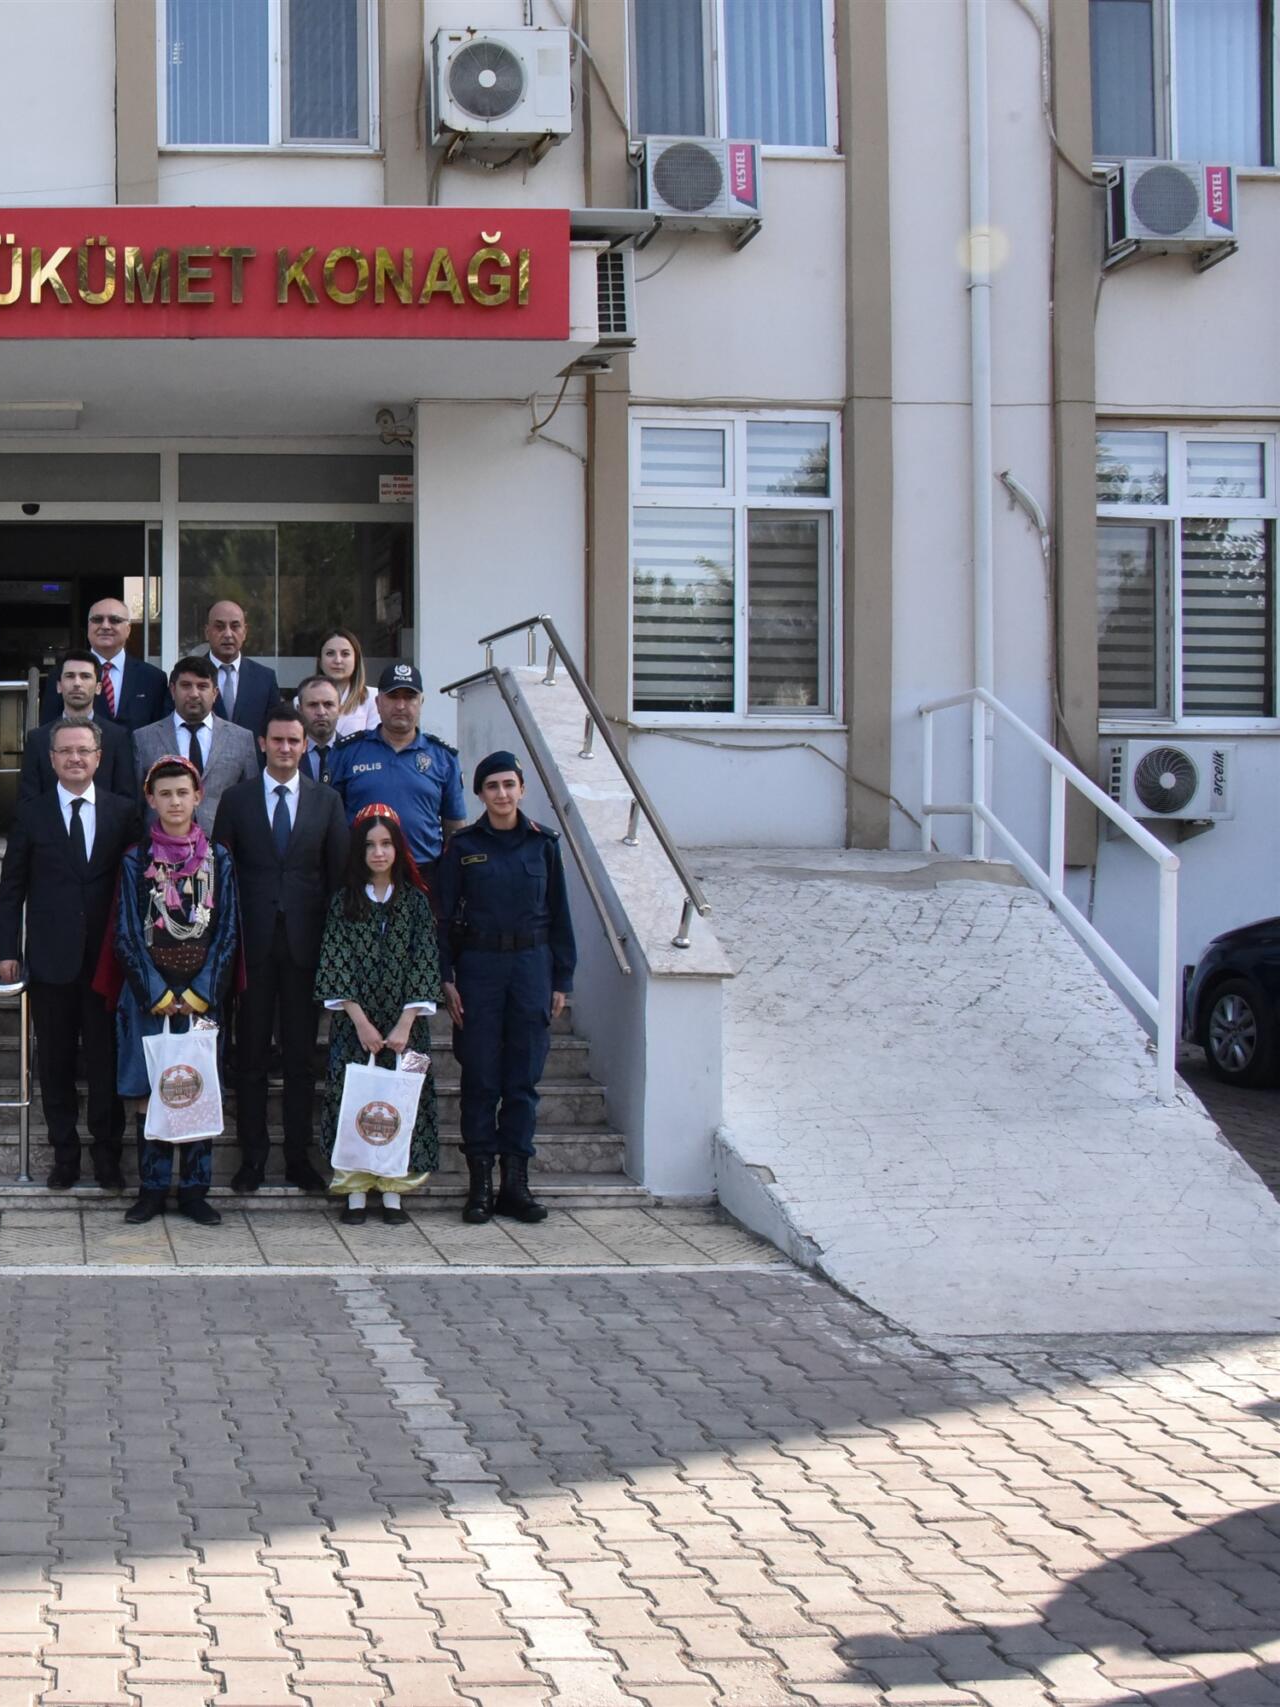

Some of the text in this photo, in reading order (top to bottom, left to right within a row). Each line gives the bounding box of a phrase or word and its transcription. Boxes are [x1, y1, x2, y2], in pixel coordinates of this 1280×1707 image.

[735, 149, 747, 191] VESTEL
[1212, 172, 1223, 213] VESTEL
[276, 230, 532, 307] KONAĞI
[1212, 750, 1226, 796] arçelik
